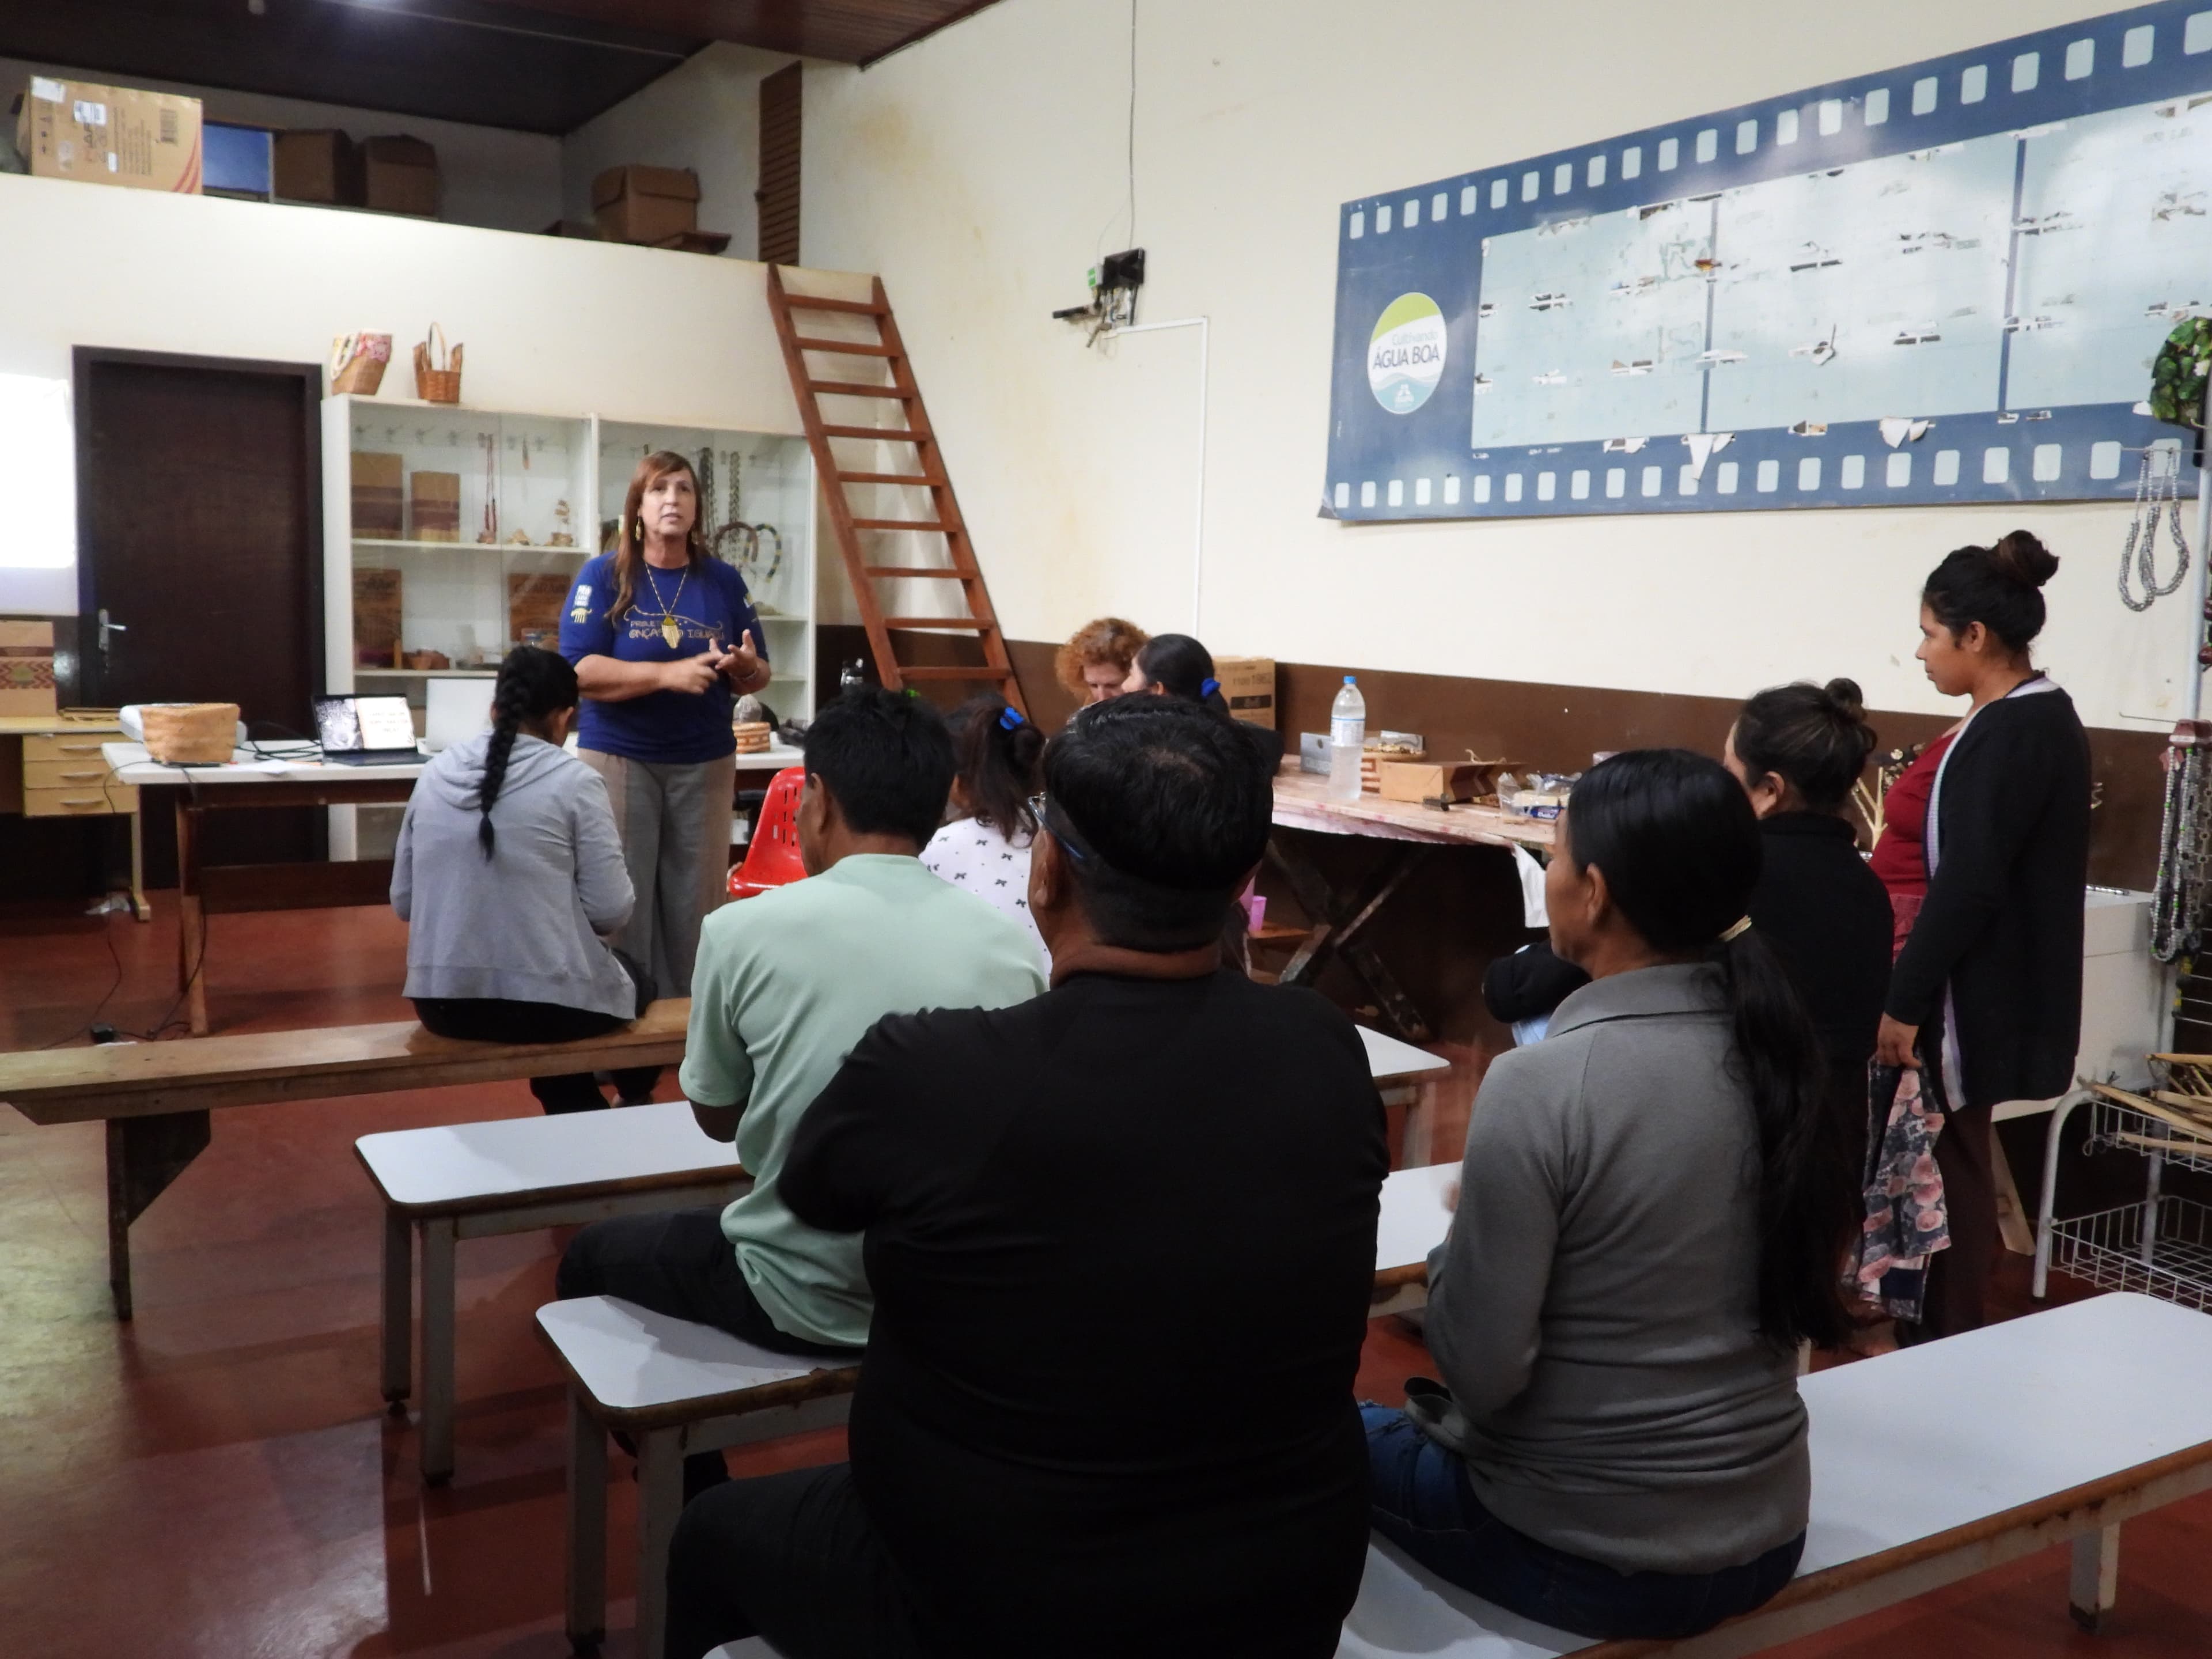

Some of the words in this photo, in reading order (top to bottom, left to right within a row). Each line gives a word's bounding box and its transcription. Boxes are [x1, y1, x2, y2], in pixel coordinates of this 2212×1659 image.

[1392, 330, 1438, 346] Cultivando
[1373, 345, 1410, 369] ÁGUA
[1412, 343, 1440, 365] BOA
